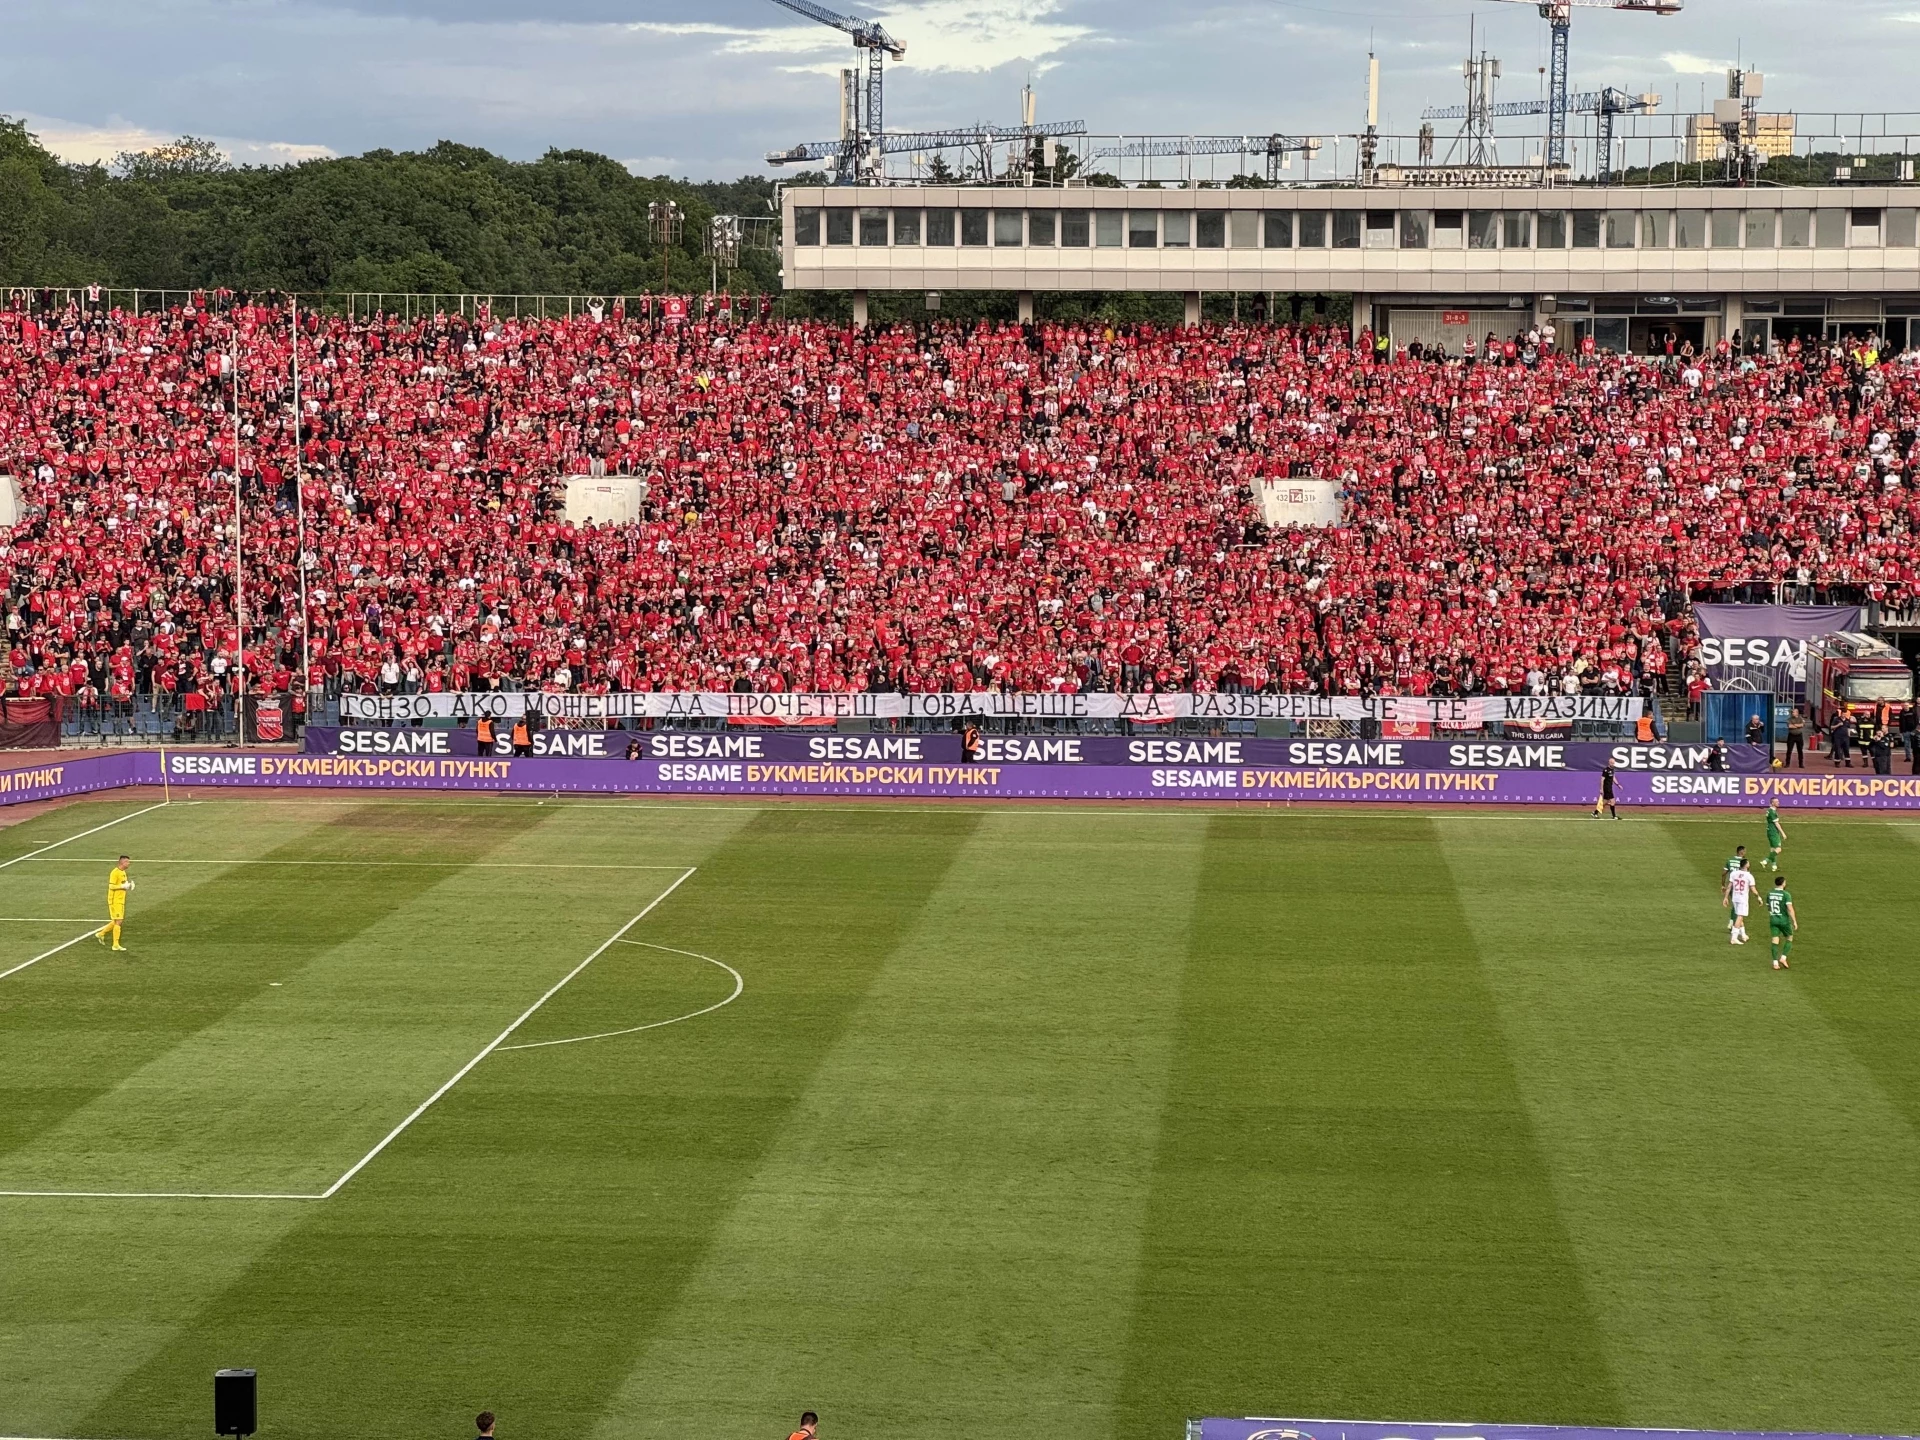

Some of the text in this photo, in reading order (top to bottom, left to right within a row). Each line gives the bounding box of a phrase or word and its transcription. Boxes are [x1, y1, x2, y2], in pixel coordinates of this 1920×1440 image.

[1290, 493, 1303, 502] 14
[344, 695, 439, 718] ГОНЗО,
[450, 694, 508, 717] АКО
[666, 694, 706, 717] ДА
[726, 694, 877, 717] ПРОЧЕТЕШ
[906, 693, 984, 716] ТОВА,
[991, 693, 1088, 718] ЩЕШЕ
[1118, 694, 1164, 718] ДА
[1190, 694, 1341, 719] РАЗБЕРЕШ,
[1361, 697, 1398, 720] ЧЕ
[1427, 699, 1467, 720] ТЕ
[1504, 696, 1630, 720] МРАЗИМ!
[1511, 731, 1564, 740] THIS IS BULGARIA
[171, 754, 511, 778] SESAME БУКМЕЙКЪРСКИ ПУНКТ
[658, 761, 1001, 785] SESAME БУКМЕЙКЪРСКИ ПУНКТ
[14, 767, 64, 791] ПУНКТ
[1151, 767, 1498, 791] SESAME БУКМЕЙКЪРСКИ ПУНКТ
[1651, 775, 1740, 795] SESAME
[1770, 900, 1780, 914] 15
